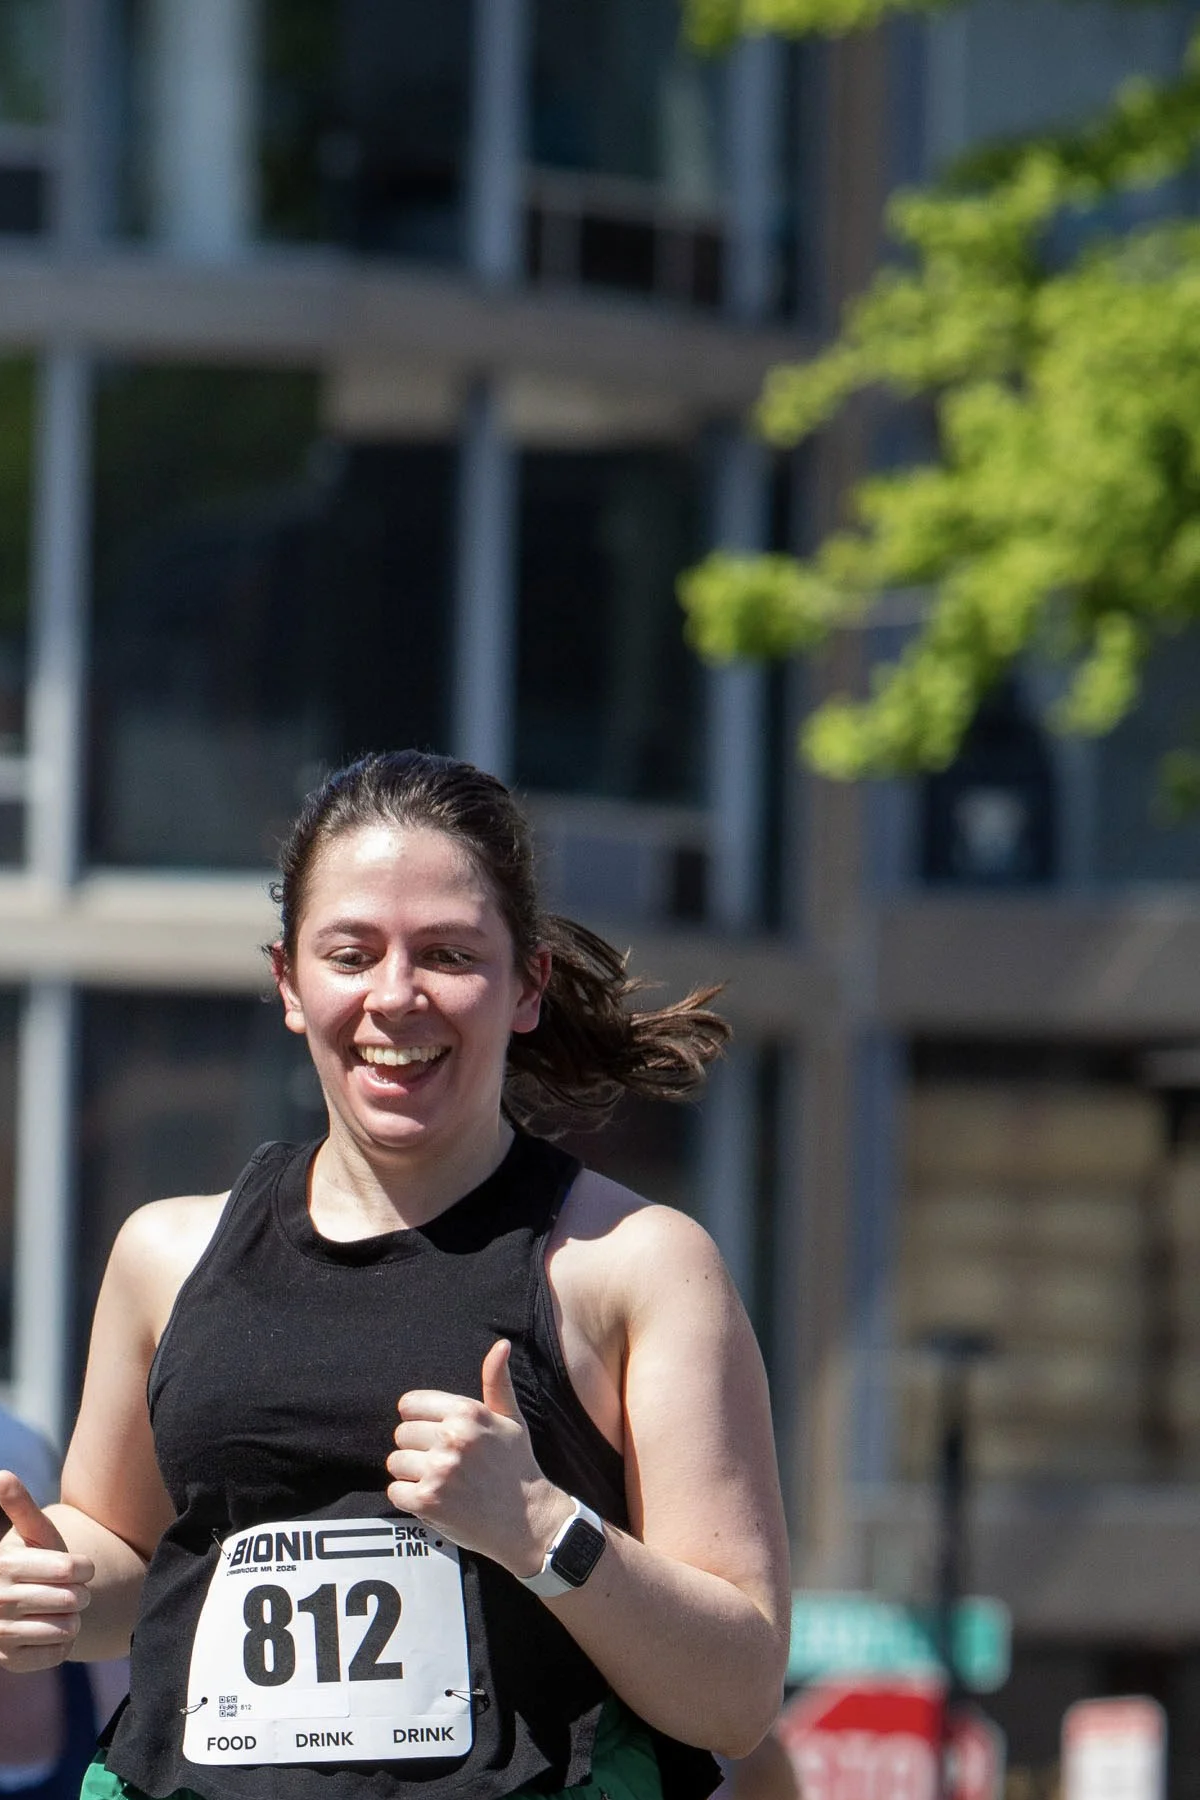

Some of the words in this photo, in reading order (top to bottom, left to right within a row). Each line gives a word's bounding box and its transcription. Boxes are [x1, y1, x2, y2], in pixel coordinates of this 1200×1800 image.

[229, 1526, 394, 1567] BIONIC
[242, 1579, 404, 1688] 812
[207, 1735, 257, 1751] FOOD
[295, 1731, 355, 1748] DRINK
[393, 1726, 455, 1744] DRINK
